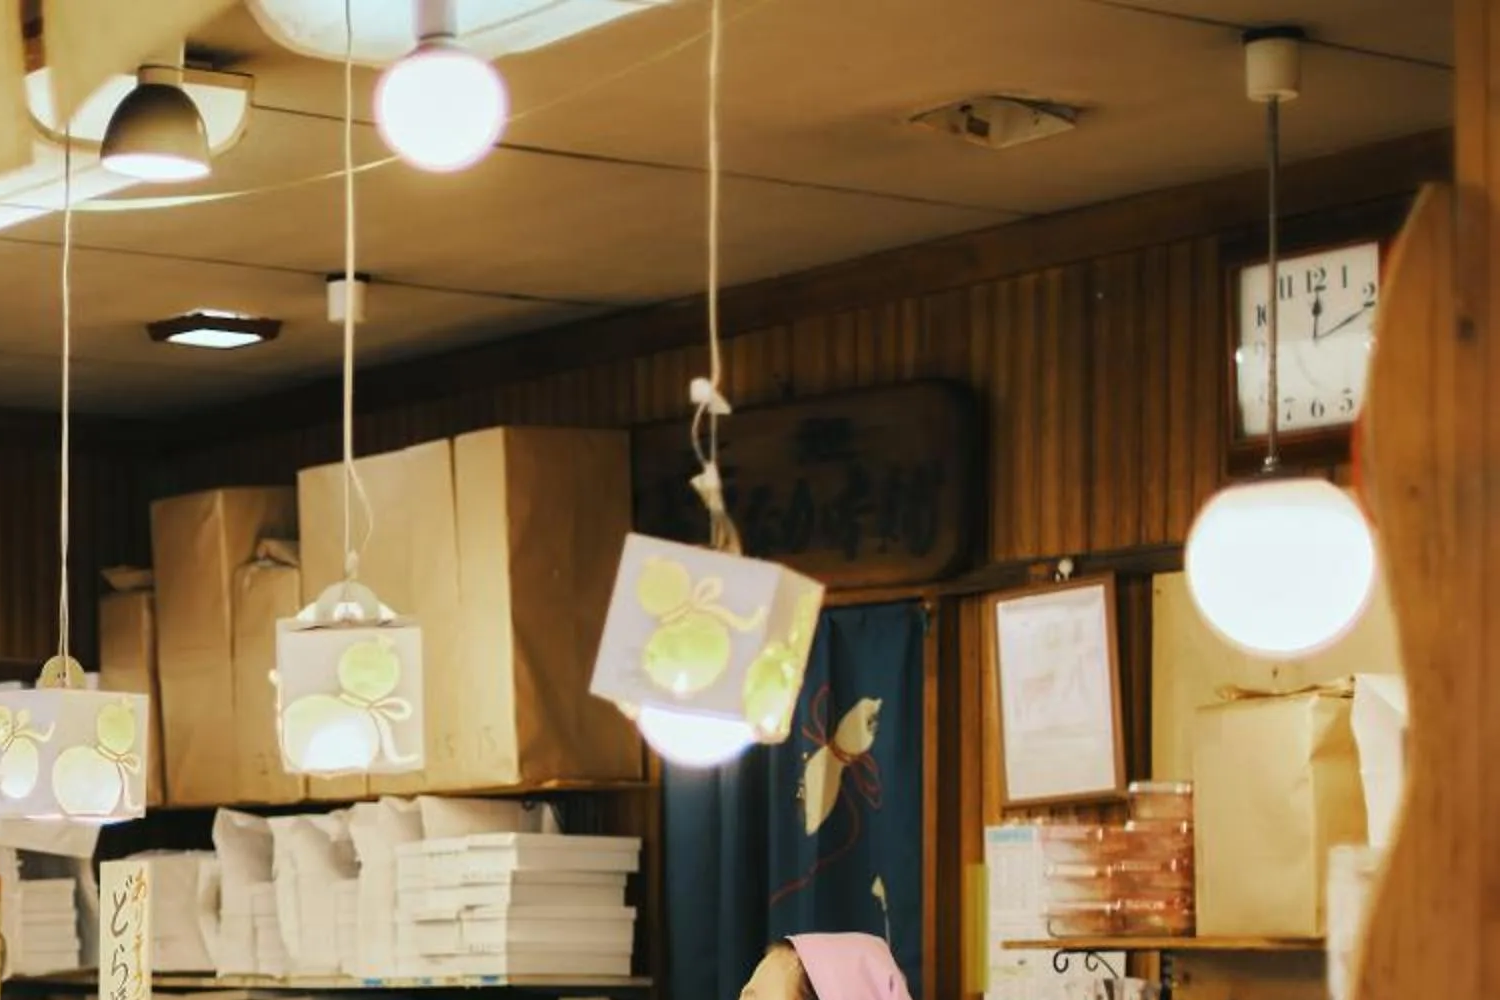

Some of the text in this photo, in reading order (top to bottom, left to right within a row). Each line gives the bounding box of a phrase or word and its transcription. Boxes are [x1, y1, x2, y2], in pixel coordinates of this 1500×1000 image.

[1279, 275, 1293, 300] 11
[1306, 267, 1327, 294] 12
[1363, 282, 1376, 308] 2
